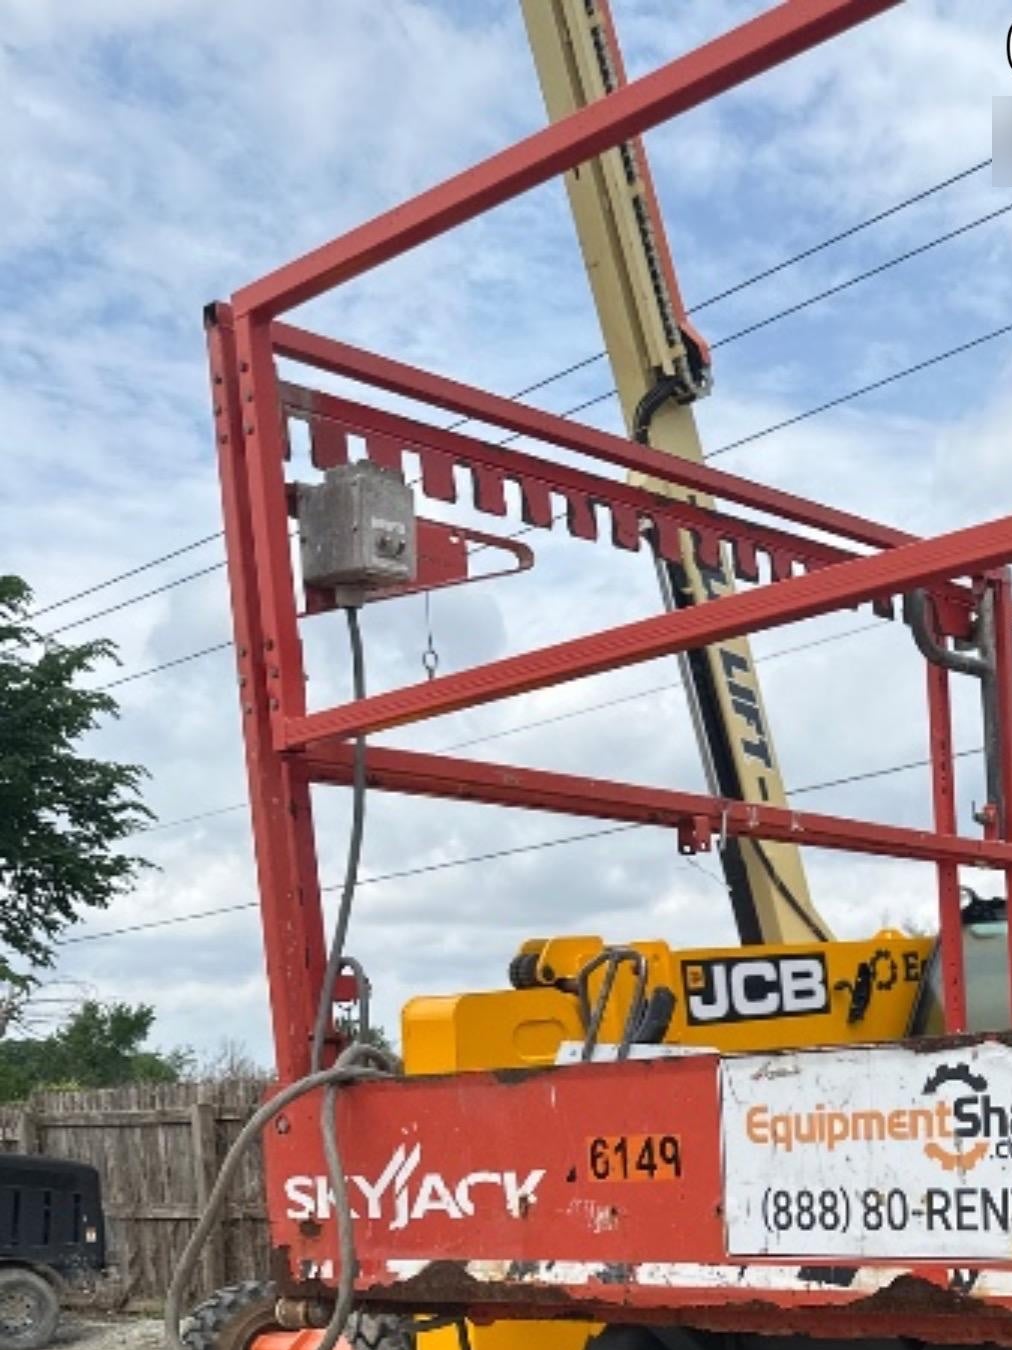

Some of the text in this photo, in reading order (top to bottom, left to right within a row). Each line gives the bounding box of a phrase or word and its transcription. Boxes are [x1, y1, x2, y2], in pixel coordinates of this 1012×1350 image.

[689, 958, 827, 1020] JCB
[590, 1136, 681, 1180] 6149
[762, 1187, 850, 1233] (888)
